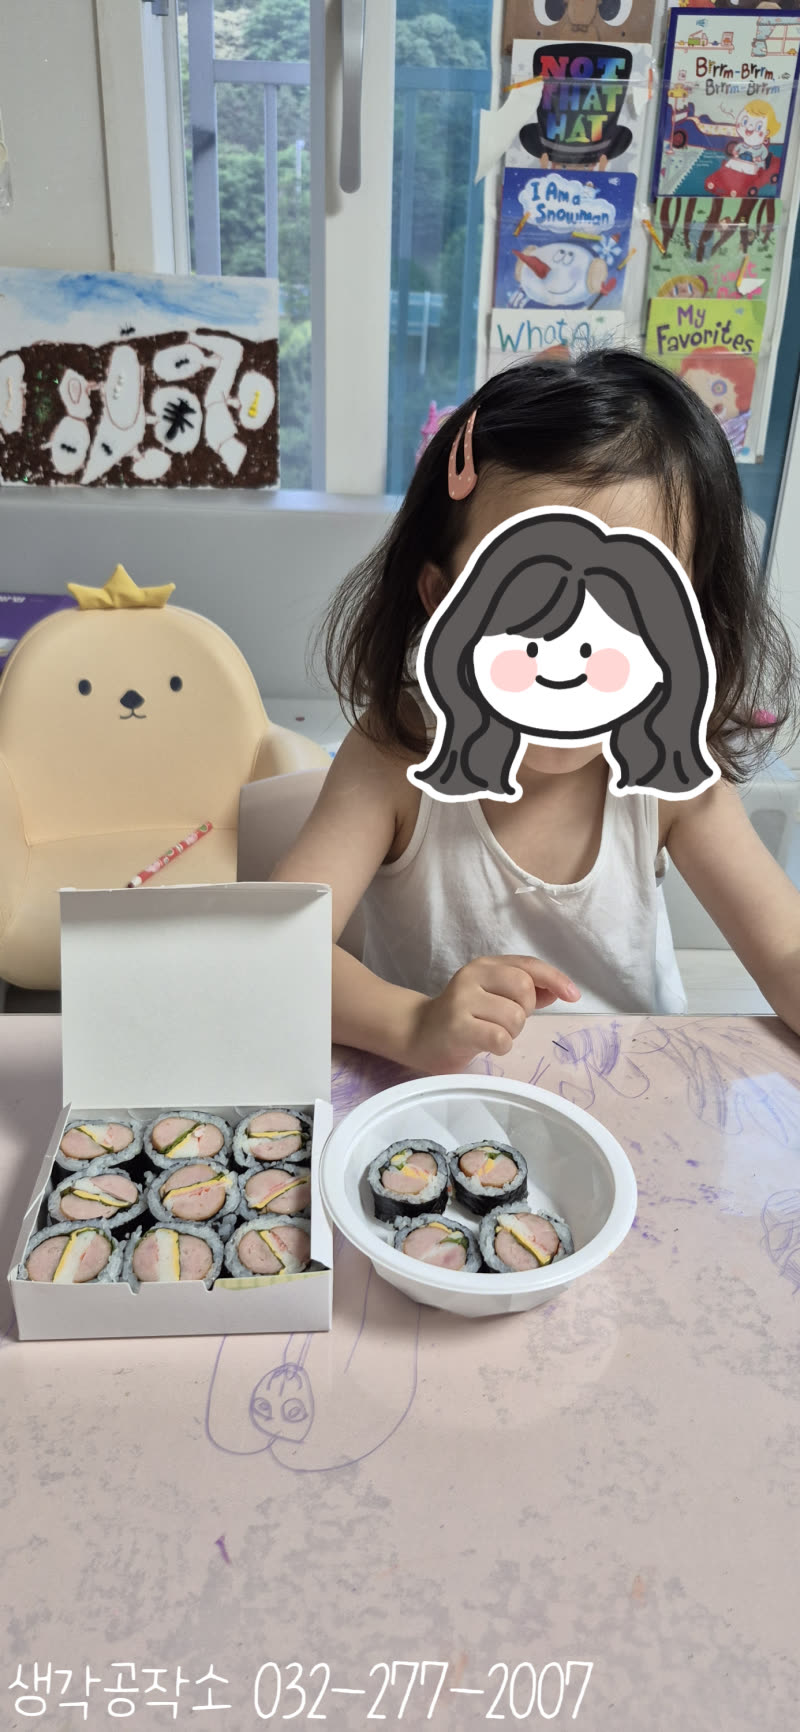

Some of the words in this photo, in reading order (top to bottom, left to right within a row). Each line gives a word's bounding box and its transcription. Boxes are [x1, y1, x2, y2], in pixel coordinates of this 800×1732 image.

[541, 56, 626, 81] NOT
[542, 82, 623, 112] THAT
[546, 113, 608, 143] HAT
[530, 181, 540, 201] I
[545, 181, 569, 203] Am
[572, 194, 581, 206] a
[535, 203, 609, 226] Snowman
[677, 304, 706, 329] My
[497, 318, 568, 352] What
[656, 320, 755, 355] Favorites
